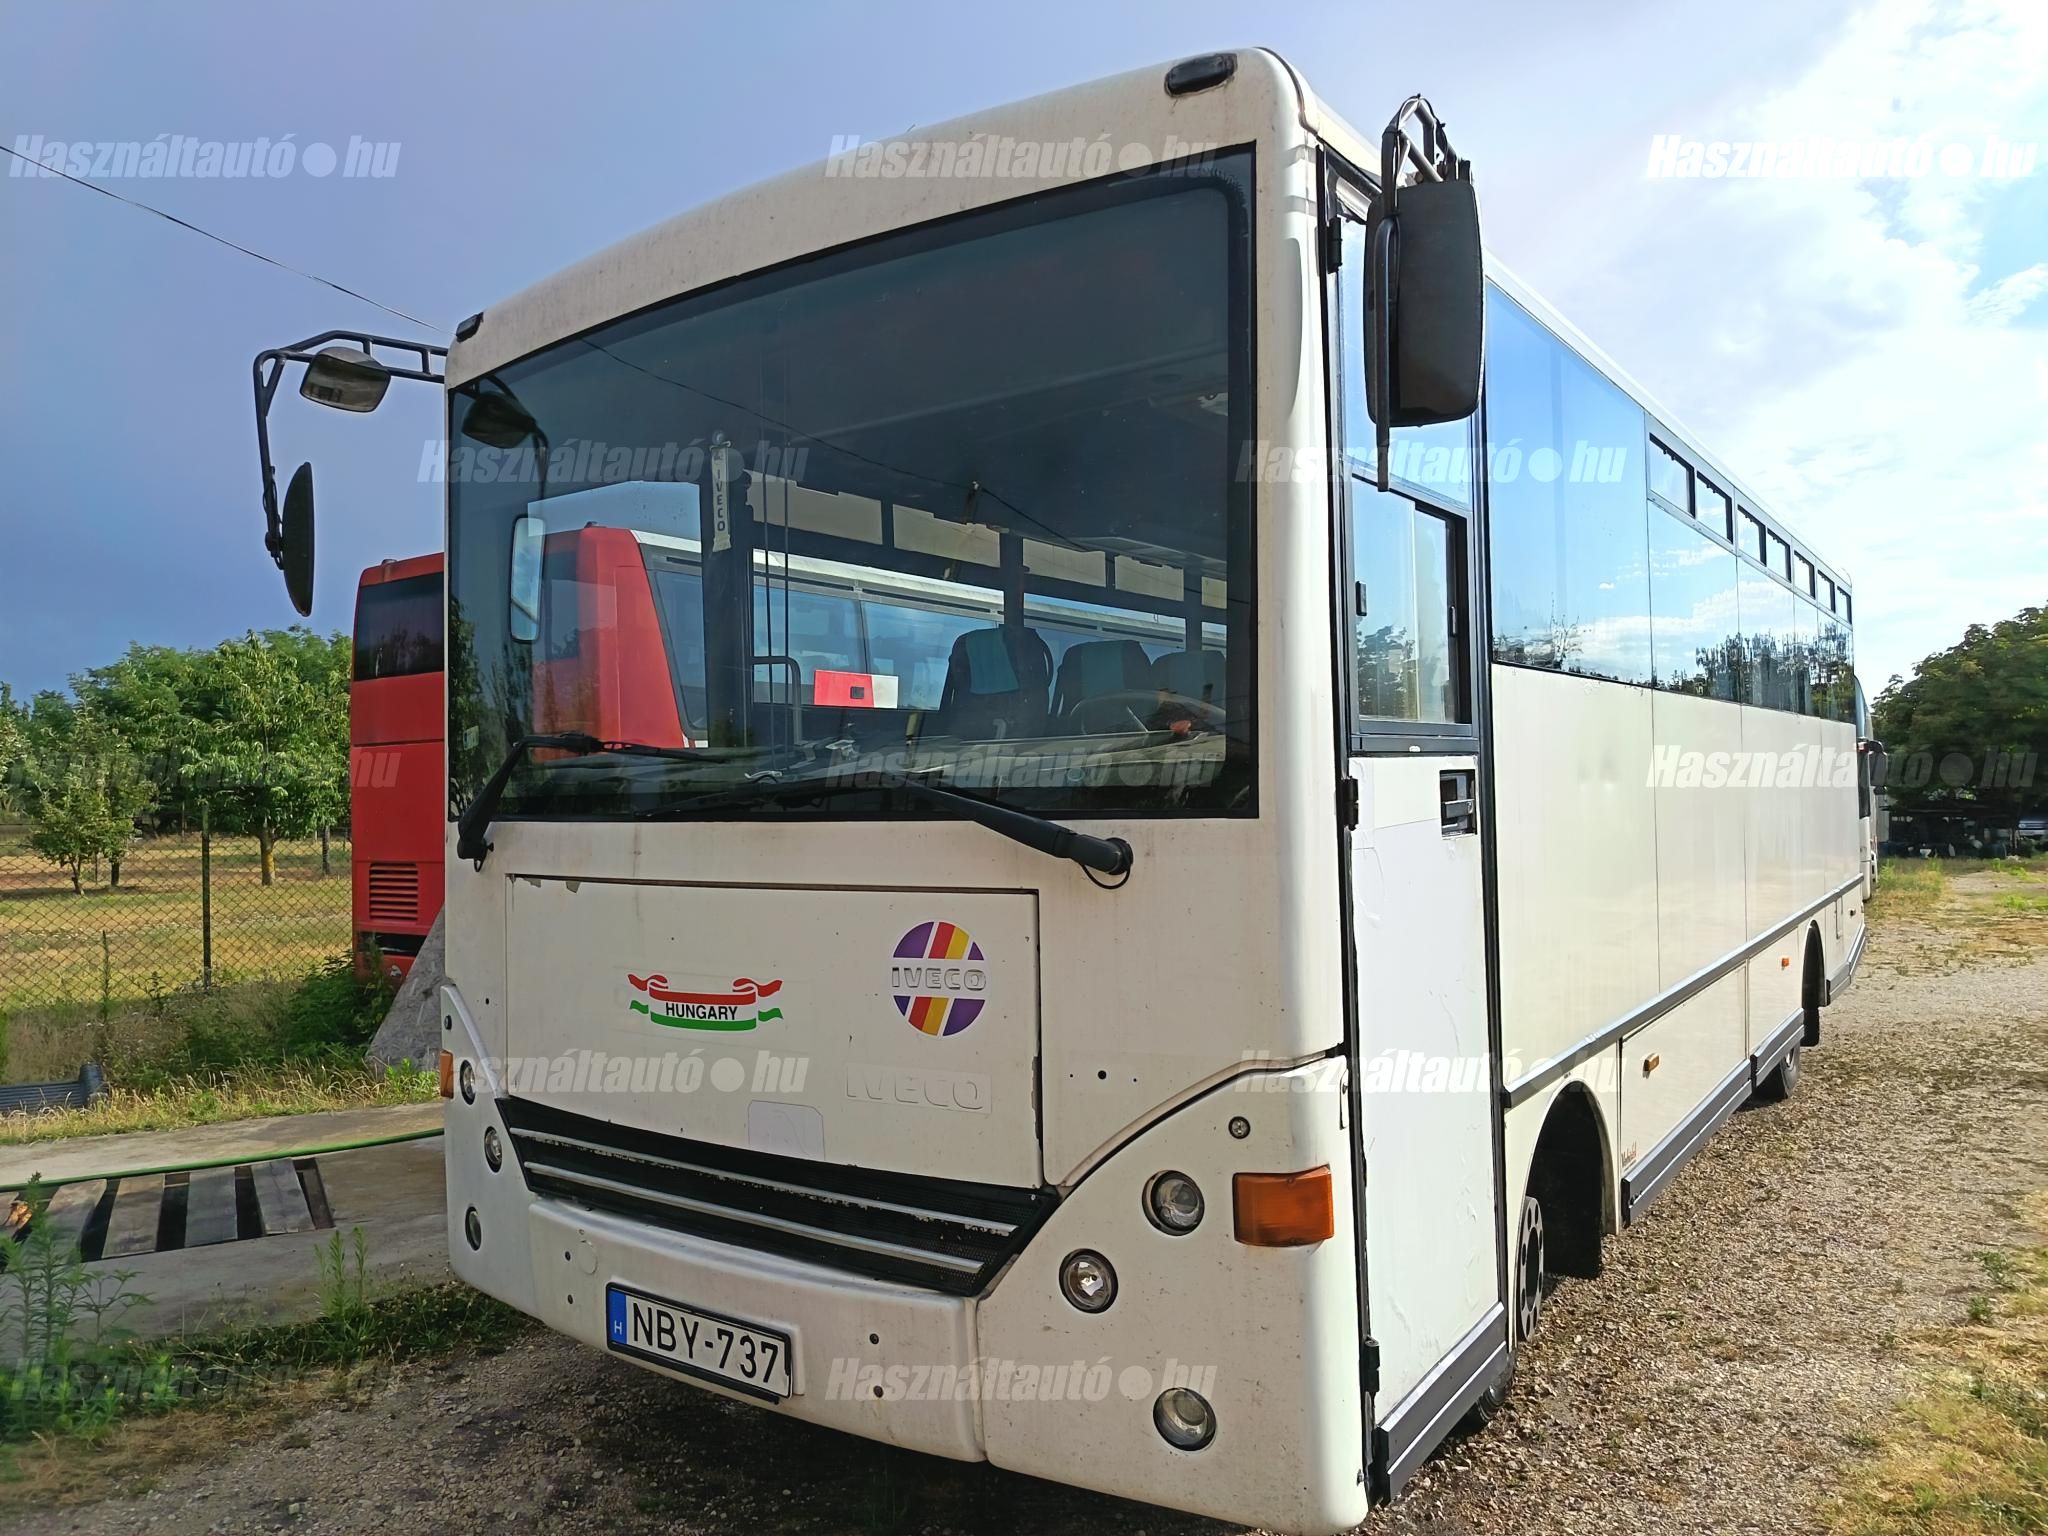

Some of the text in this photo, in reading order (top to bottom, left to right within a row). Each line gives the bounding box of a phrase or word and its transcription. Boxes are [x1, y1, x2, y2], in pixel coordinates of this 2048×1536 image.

[716, 469, 726, 532] IVECO
[891, 966, 987, 992] IVECO
[665, 1001, 738, 1021] HUNGARY
[632, 1302, 779, 1384] NBY-737
